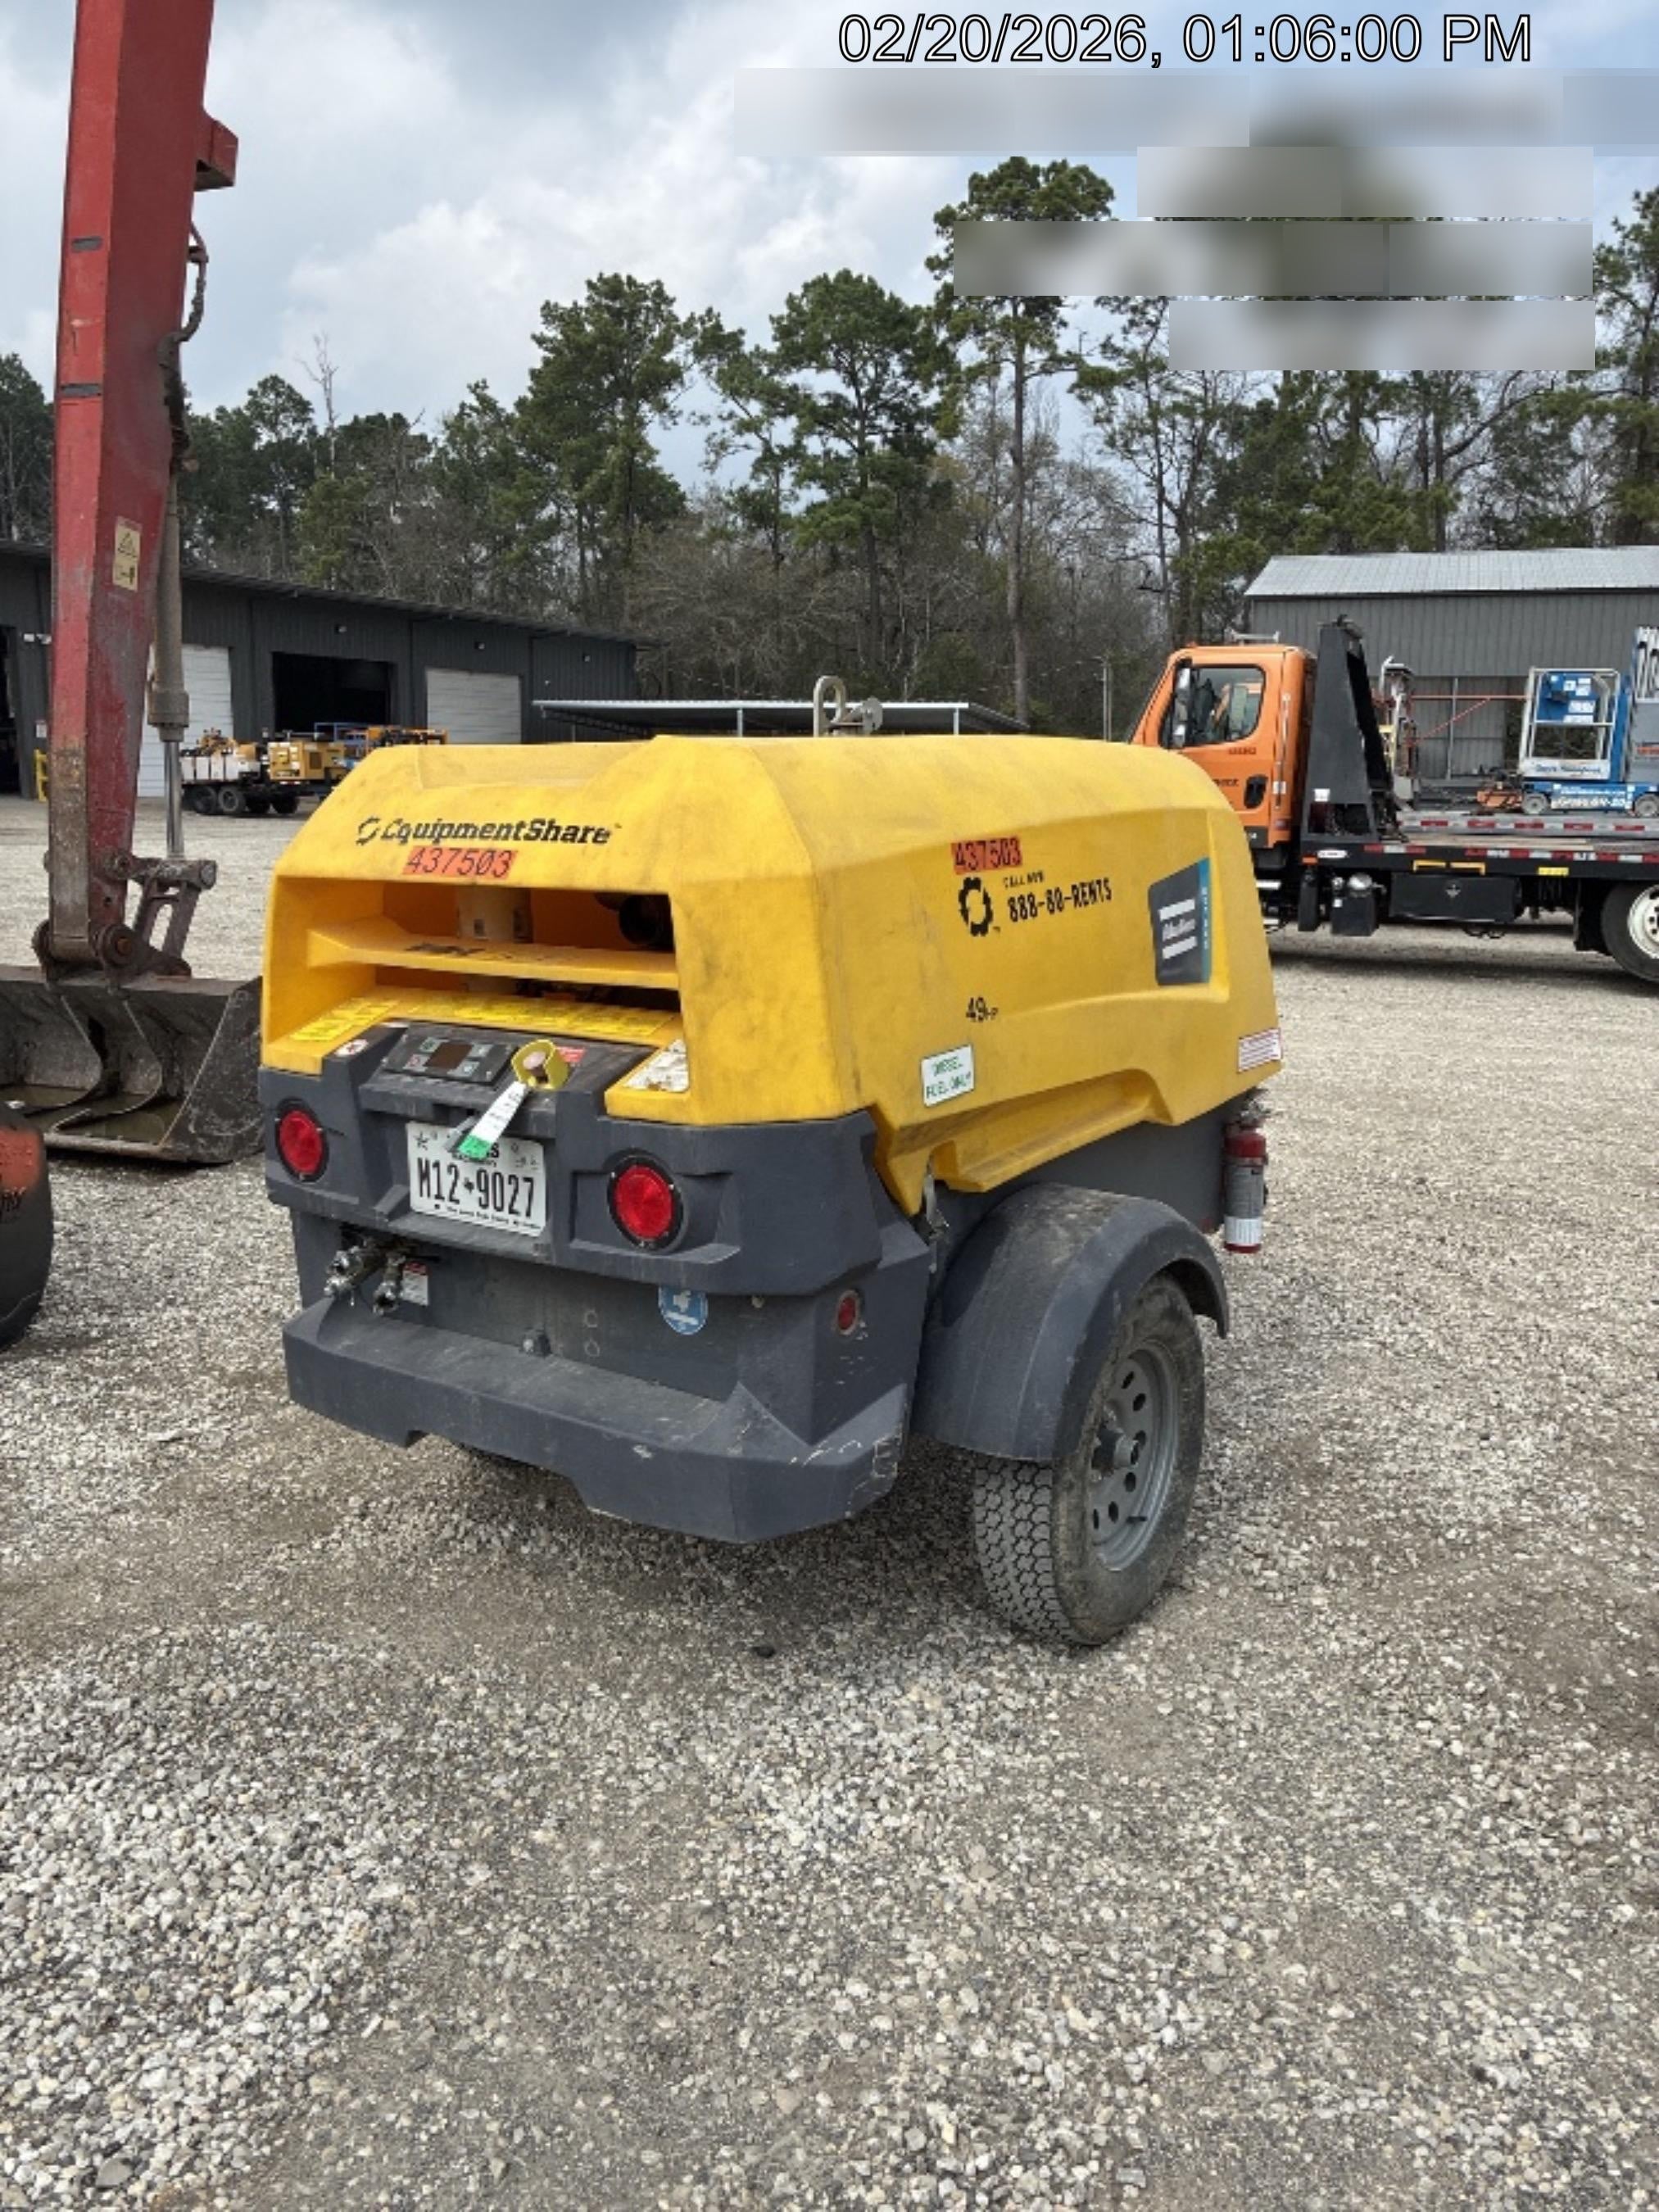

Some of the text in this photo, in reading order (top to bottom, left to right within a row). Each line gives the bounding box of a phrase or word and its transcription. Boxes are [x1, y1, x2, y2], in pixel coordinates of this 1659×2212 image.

[380, 818, 612, 846] EquipmentShare
[406, 846, 515, 878] 437503
[954, 837, 1022, 871] 437503
[1007, 877, 1113, 923] 888-80-RENTS
